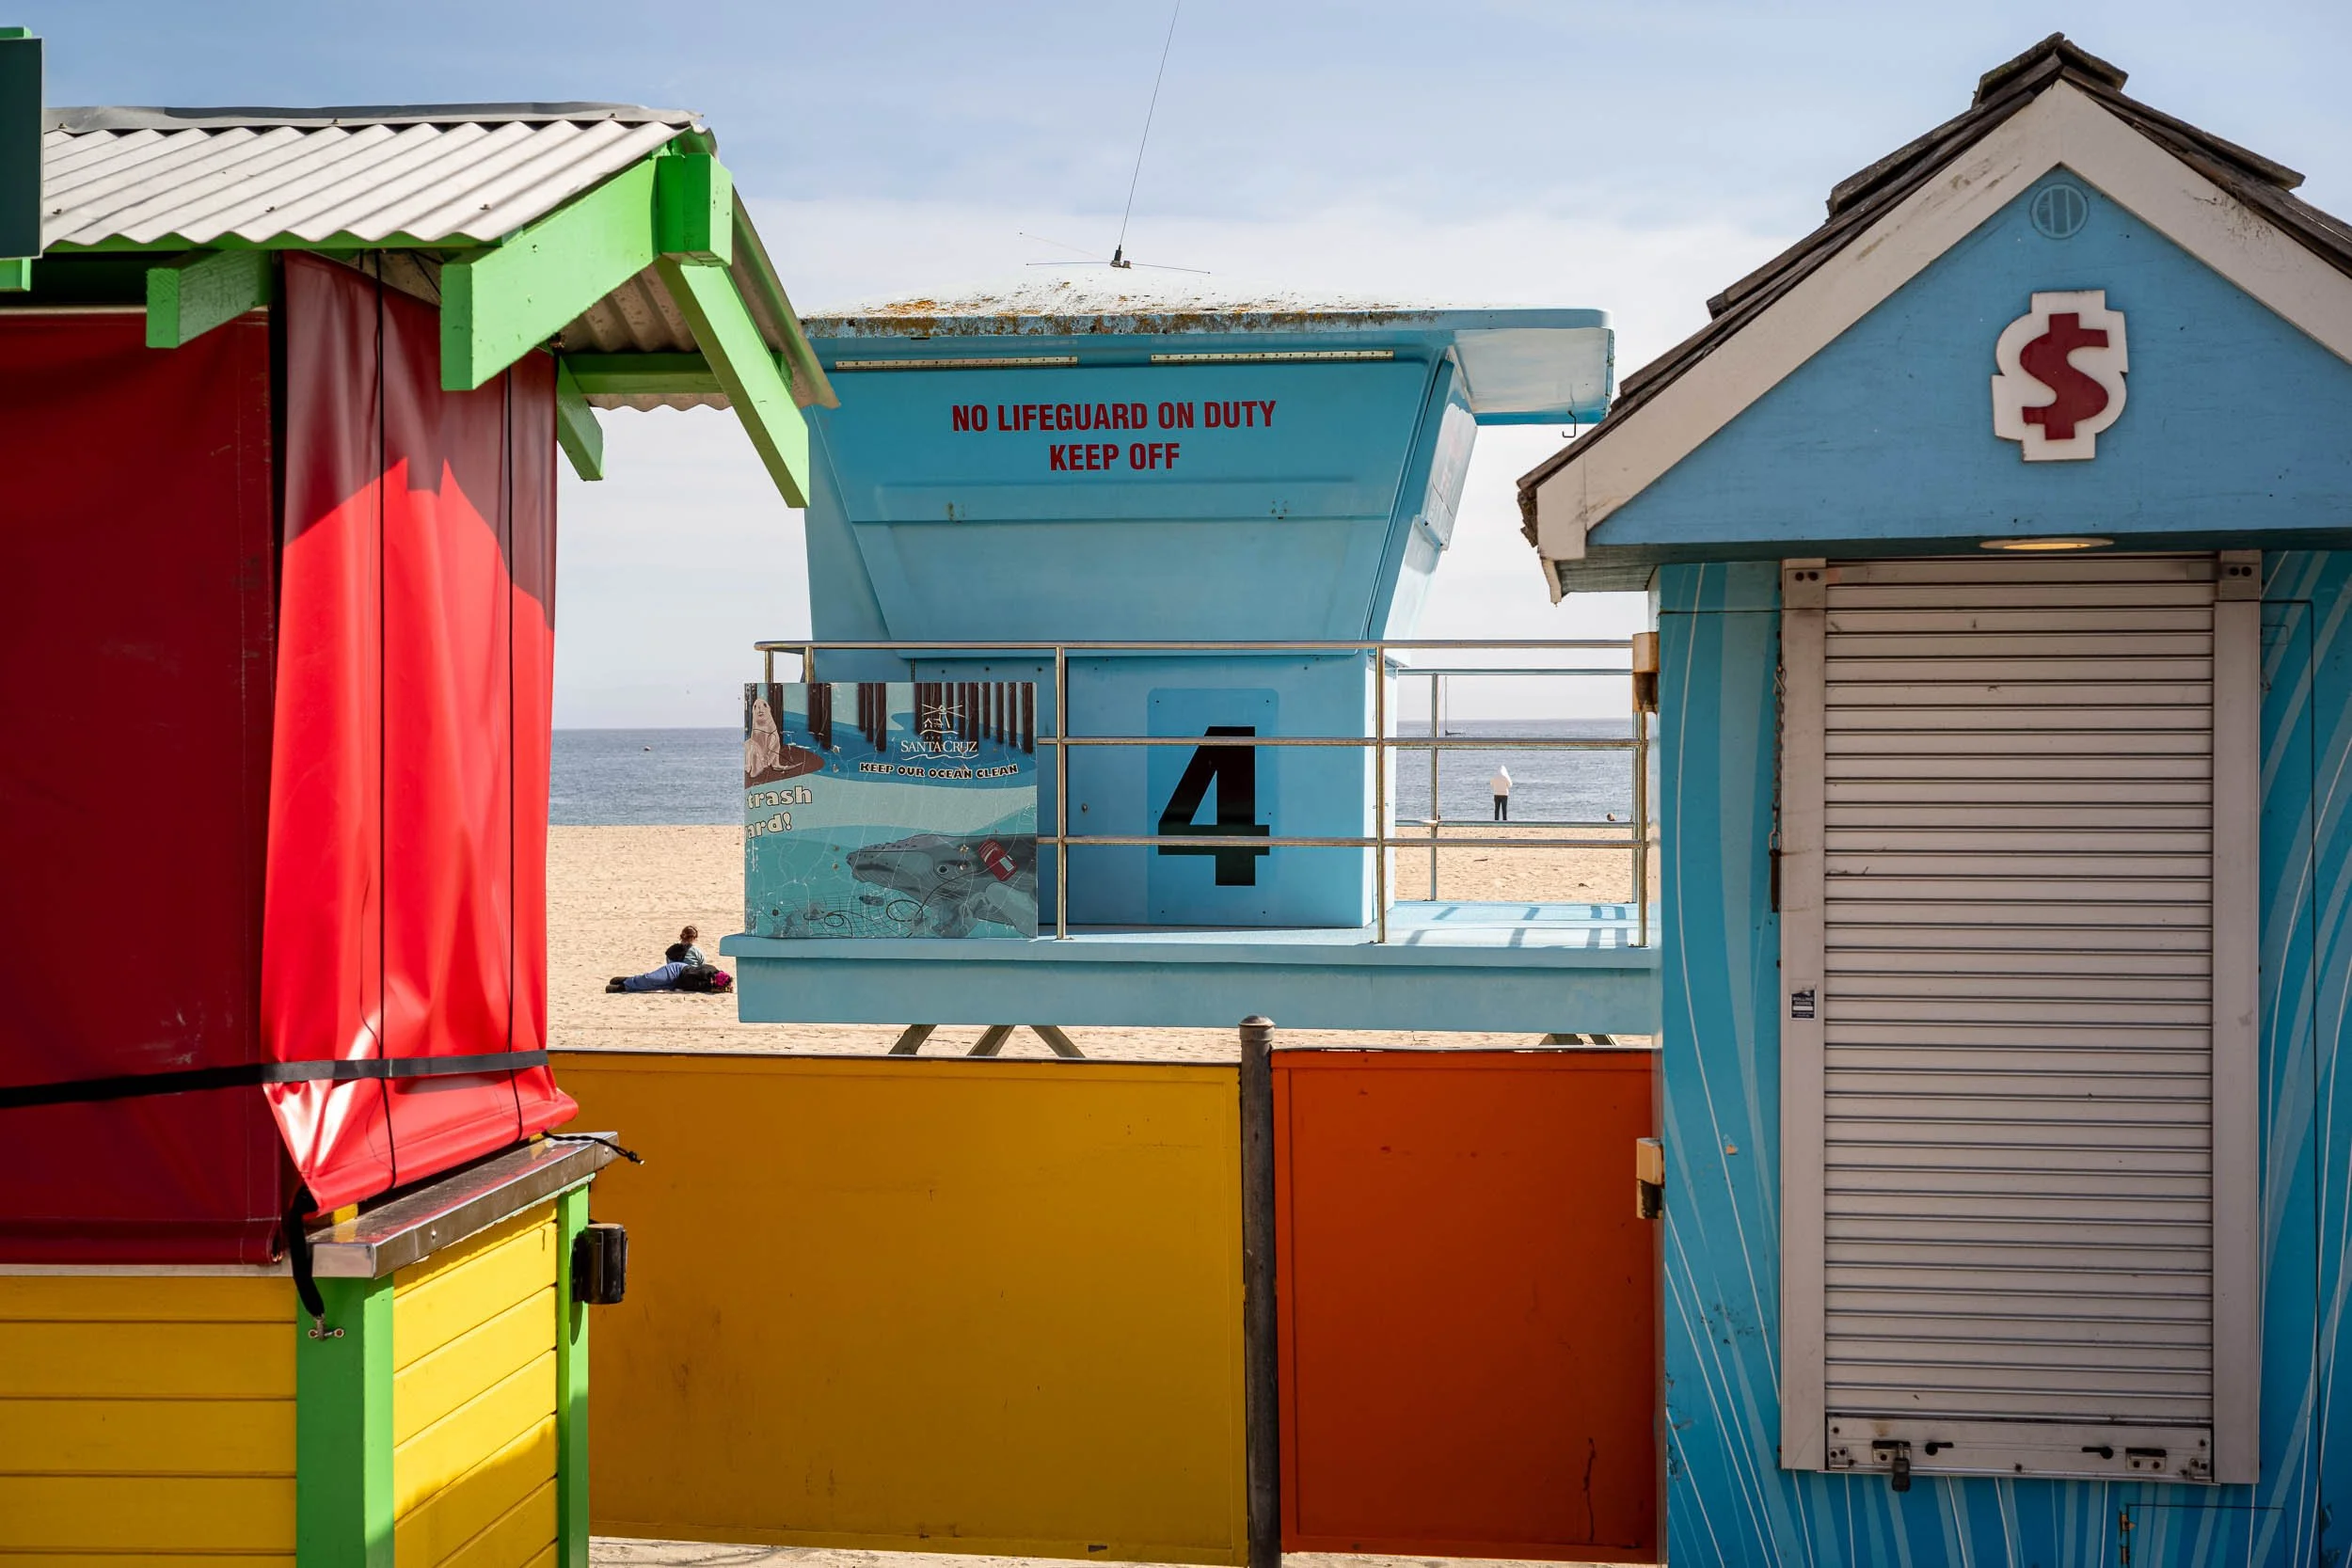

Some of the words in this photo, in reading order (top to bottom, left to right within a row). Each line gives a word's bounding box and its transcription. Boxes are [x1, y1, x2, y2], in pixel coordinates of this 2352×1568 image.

[952, 404, 988, 432] NO
[997, 403, 1148, 431] LIFEGUARD
[1158, 402, 1194, 429] ON
[1204, 401, 1277, 428] DUTY
[1050, 444, 1120, 470] KEEP
[1129, 443, 1181, 469] OFF
[900, 740, 942, 752] SANTA
[942, 740, 977, 753] CRUZ
[859, 762, 895, 775] KEEP
[897, 765, 926, 777] OUR
[928, 767, 973, 780] OCEAN
[976, 764, 1019, 780] CLEAN
[747, 784, 813, 809] trash
[1158, 726, 1270, 886] 4
